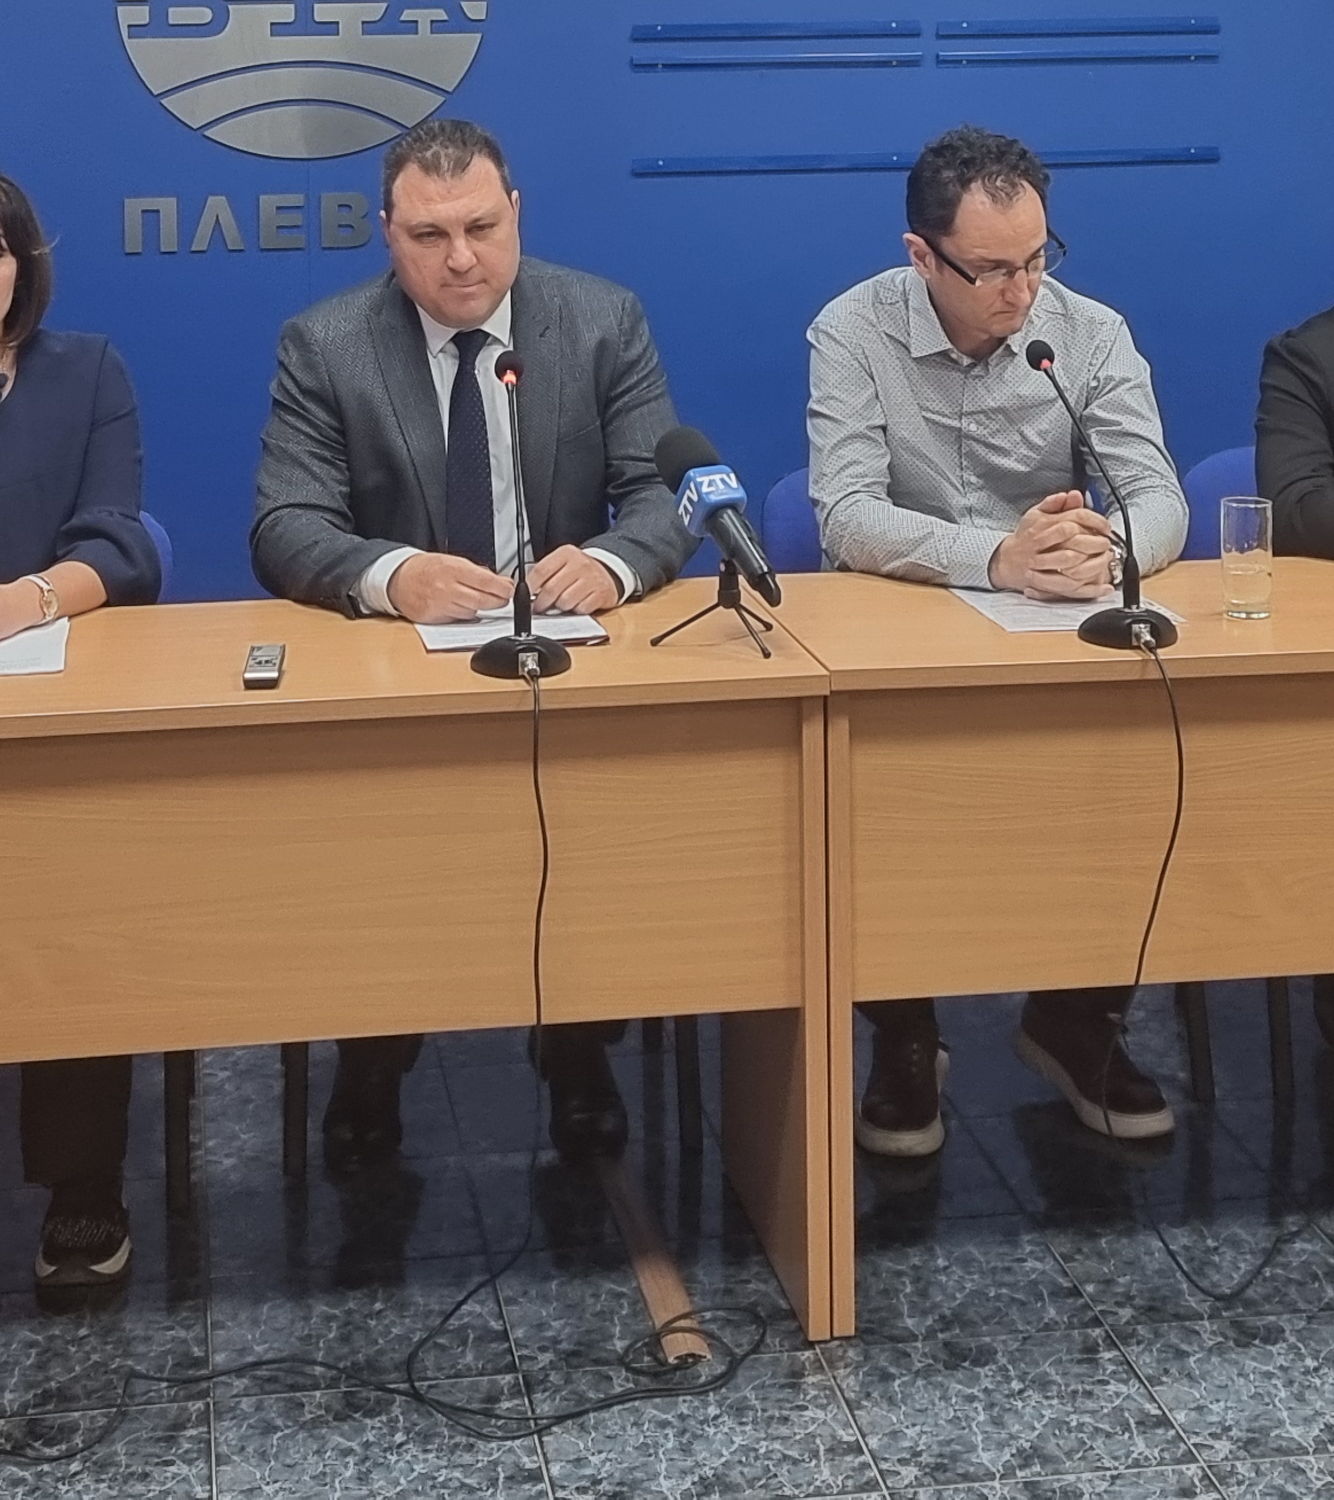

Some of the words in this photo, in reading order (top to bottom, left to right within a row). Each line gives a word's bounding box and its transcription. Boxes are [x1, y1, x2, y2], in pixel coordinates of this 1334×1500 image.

[123, 193, 373, 255] ПЛЕВ
[677, 481, 699, 527] ZTV
[696, 472, 738, 493] ZTV
